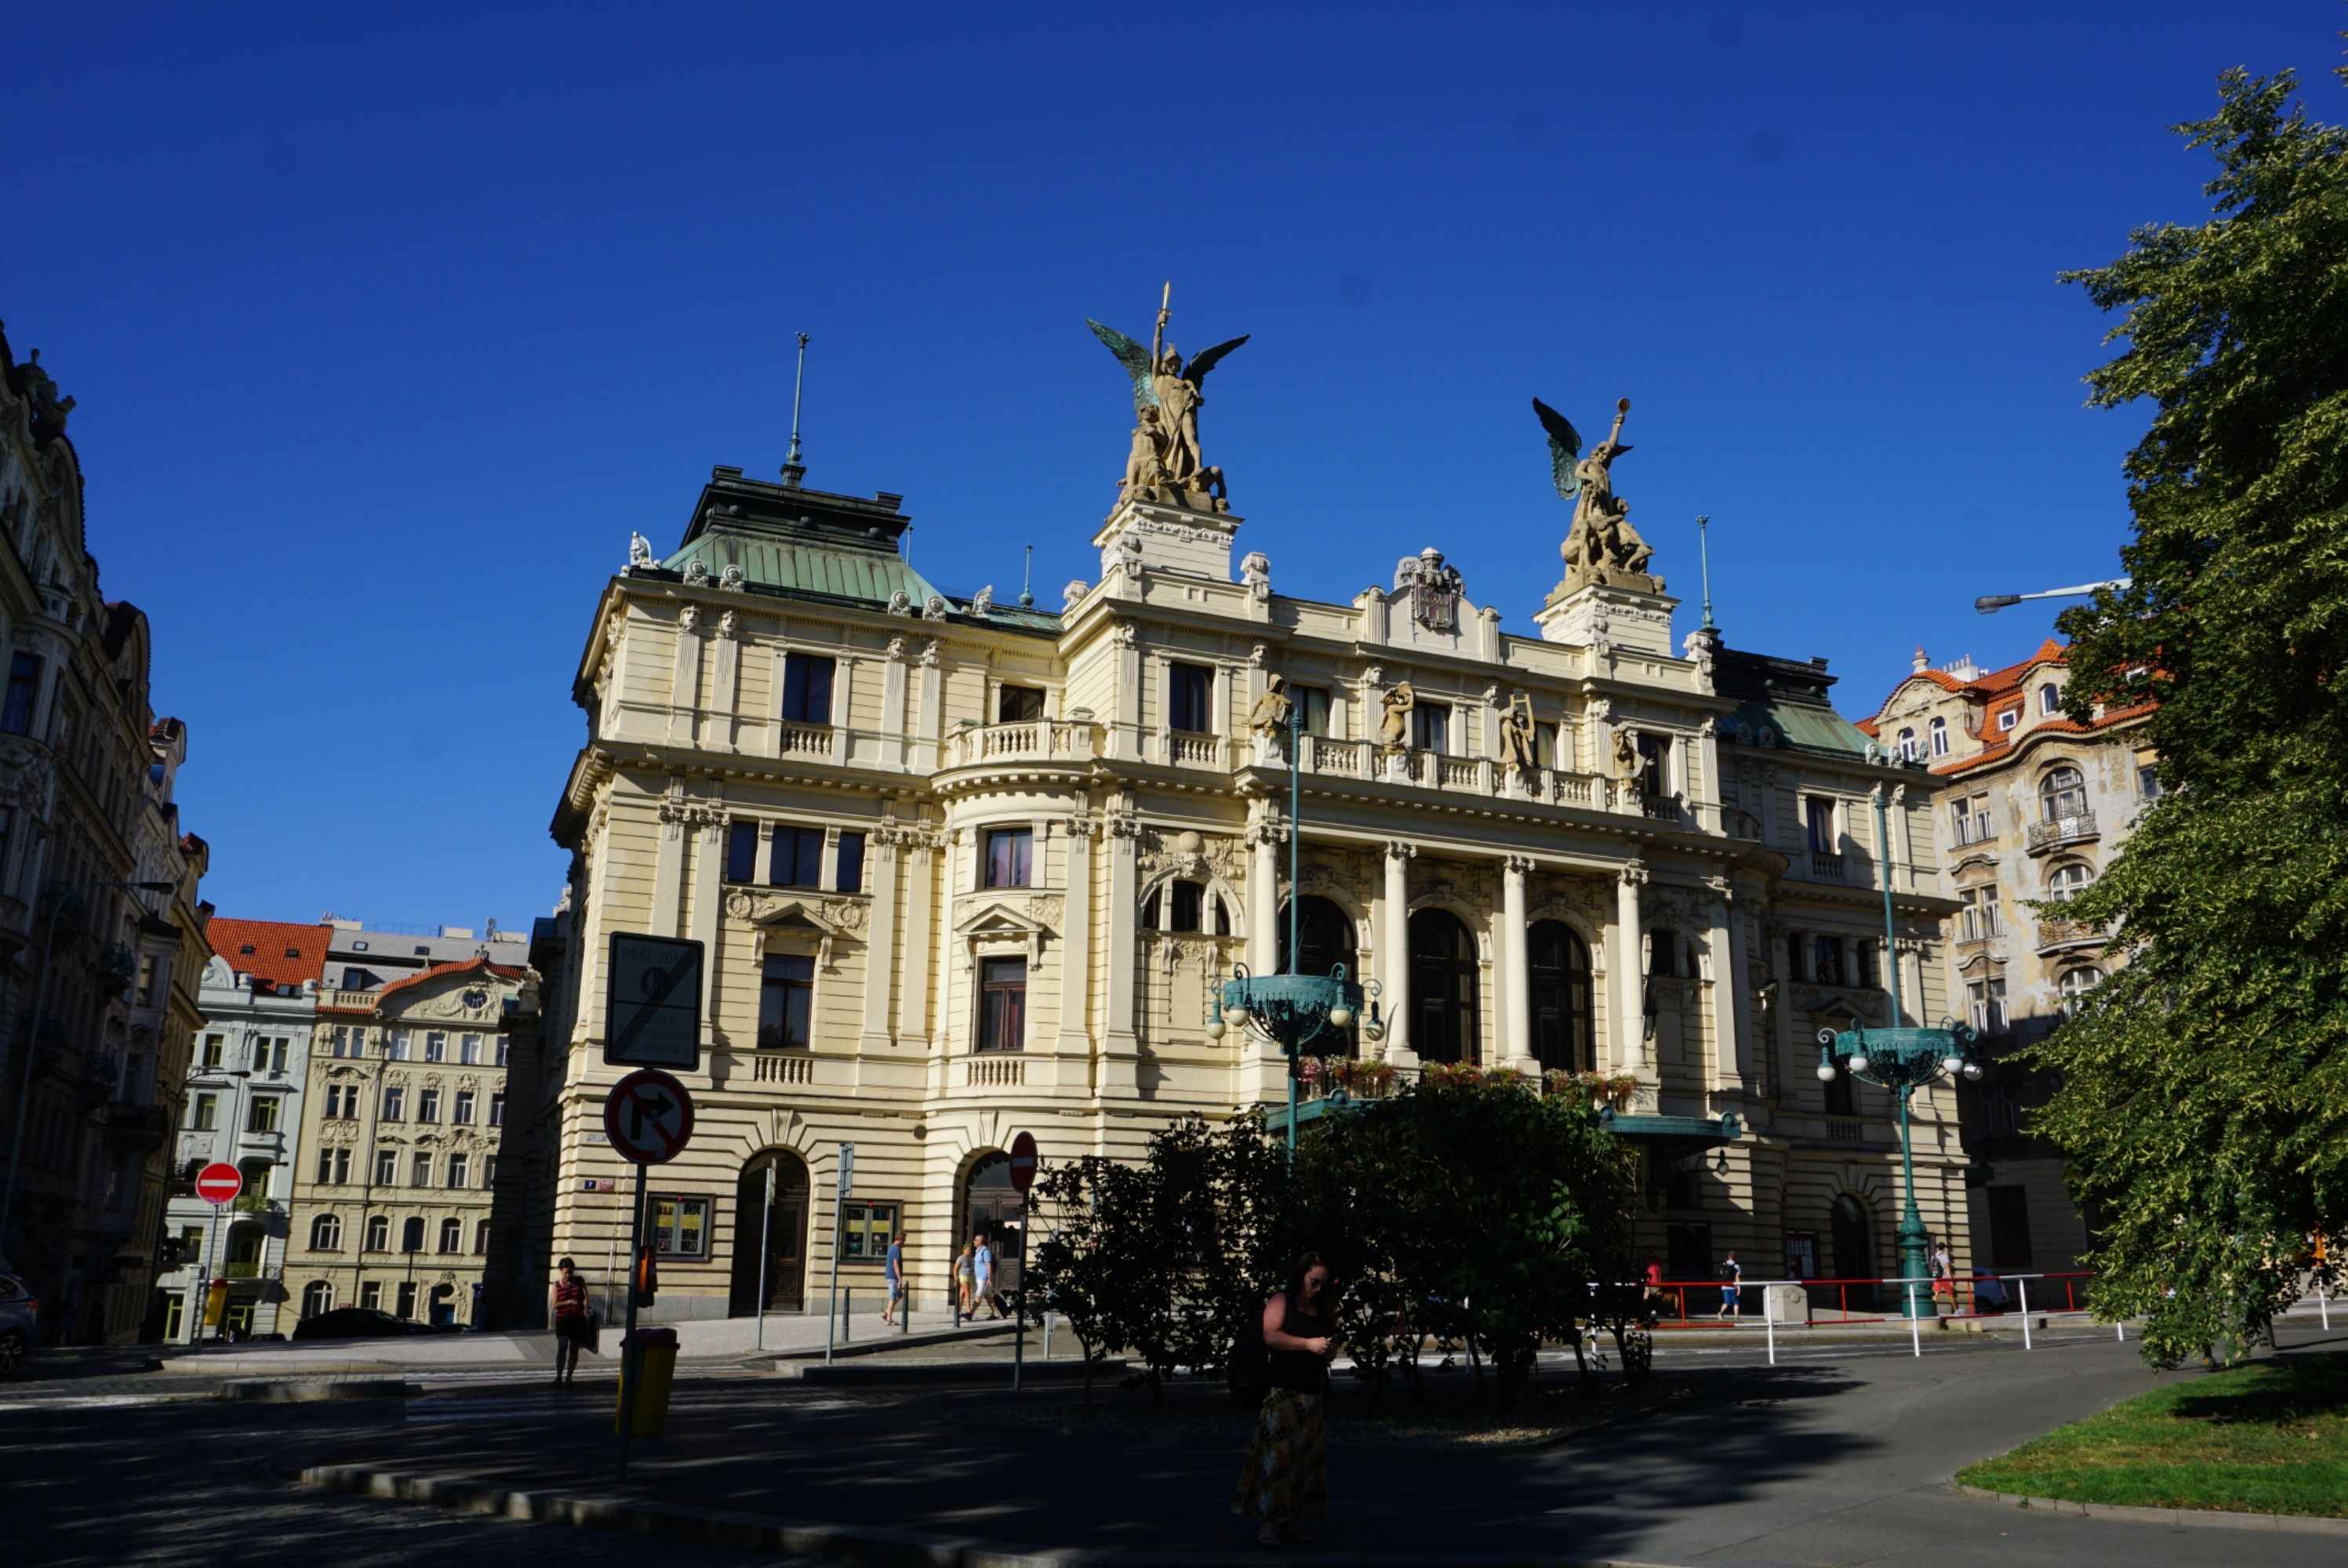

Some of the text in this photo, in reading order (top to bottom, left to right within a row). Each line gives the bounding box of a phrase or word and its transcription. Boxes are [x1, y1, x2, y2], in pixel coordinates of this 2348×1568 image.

[622, 946, 686, 964] PĚŠÍ ZÓN
[645, 1042, 680, 1054] PRAHA
